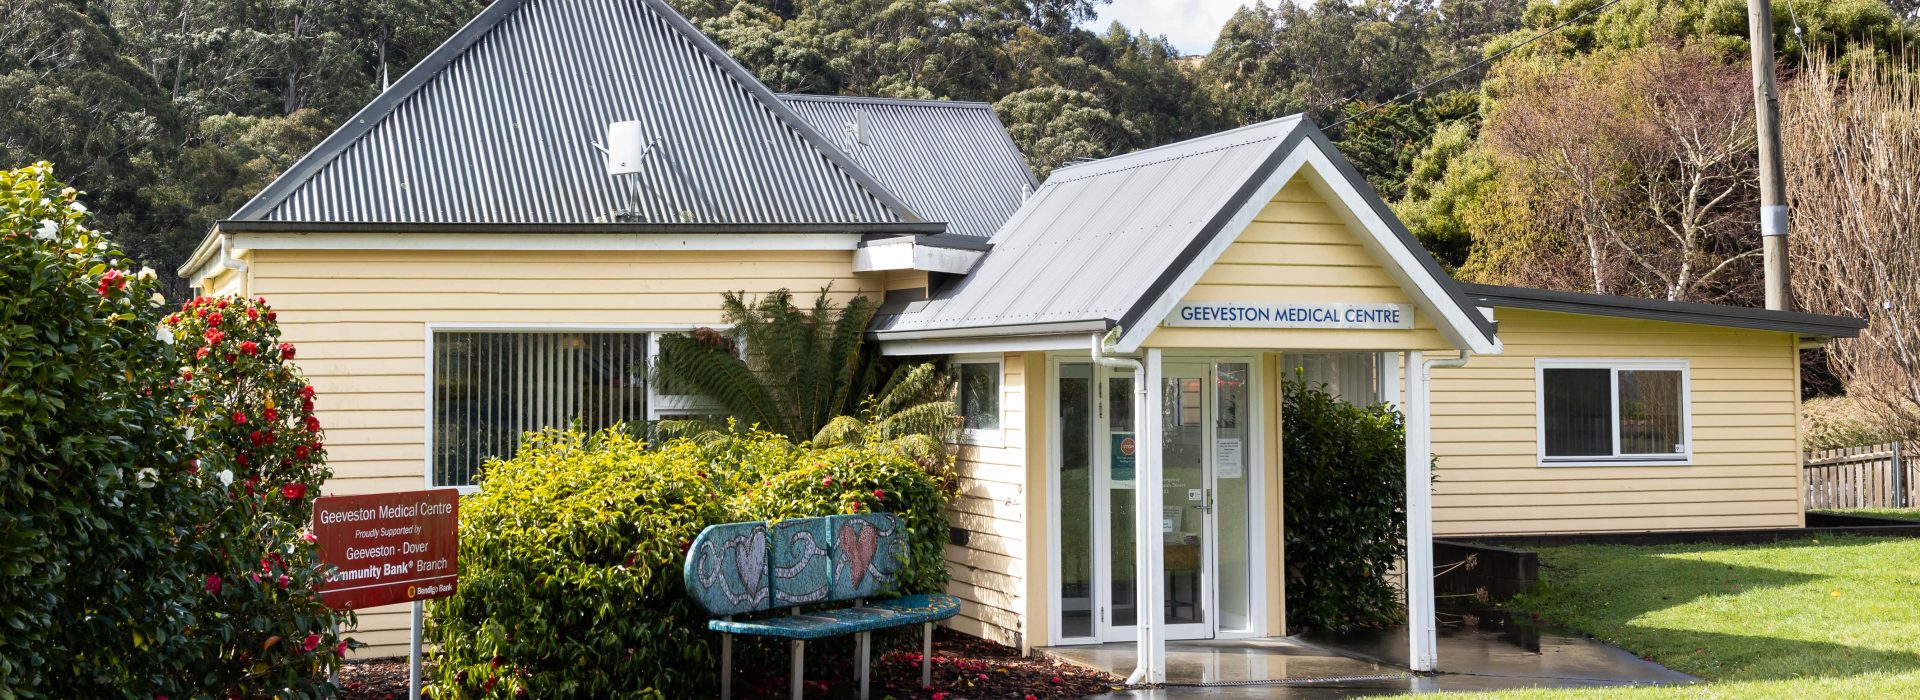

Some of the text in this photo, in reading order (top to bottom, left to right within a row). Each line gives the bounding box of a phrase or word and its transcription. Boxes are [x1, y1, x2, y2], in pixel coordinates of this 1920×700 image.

[1180, 306, 1400, 323] GEEVESTON MEDICAL CENTRE
[320, 502, 452, 525] Geeveston Medical Centre
[355, 524, 422, 539] Proudly Supported by
[346, 545, 395, 560] Geeveston
[403, 541, 429, 554] Dover
[417, 557, 448, 572] Branch
[417, 583, 453, 595] Bendigo Bank
